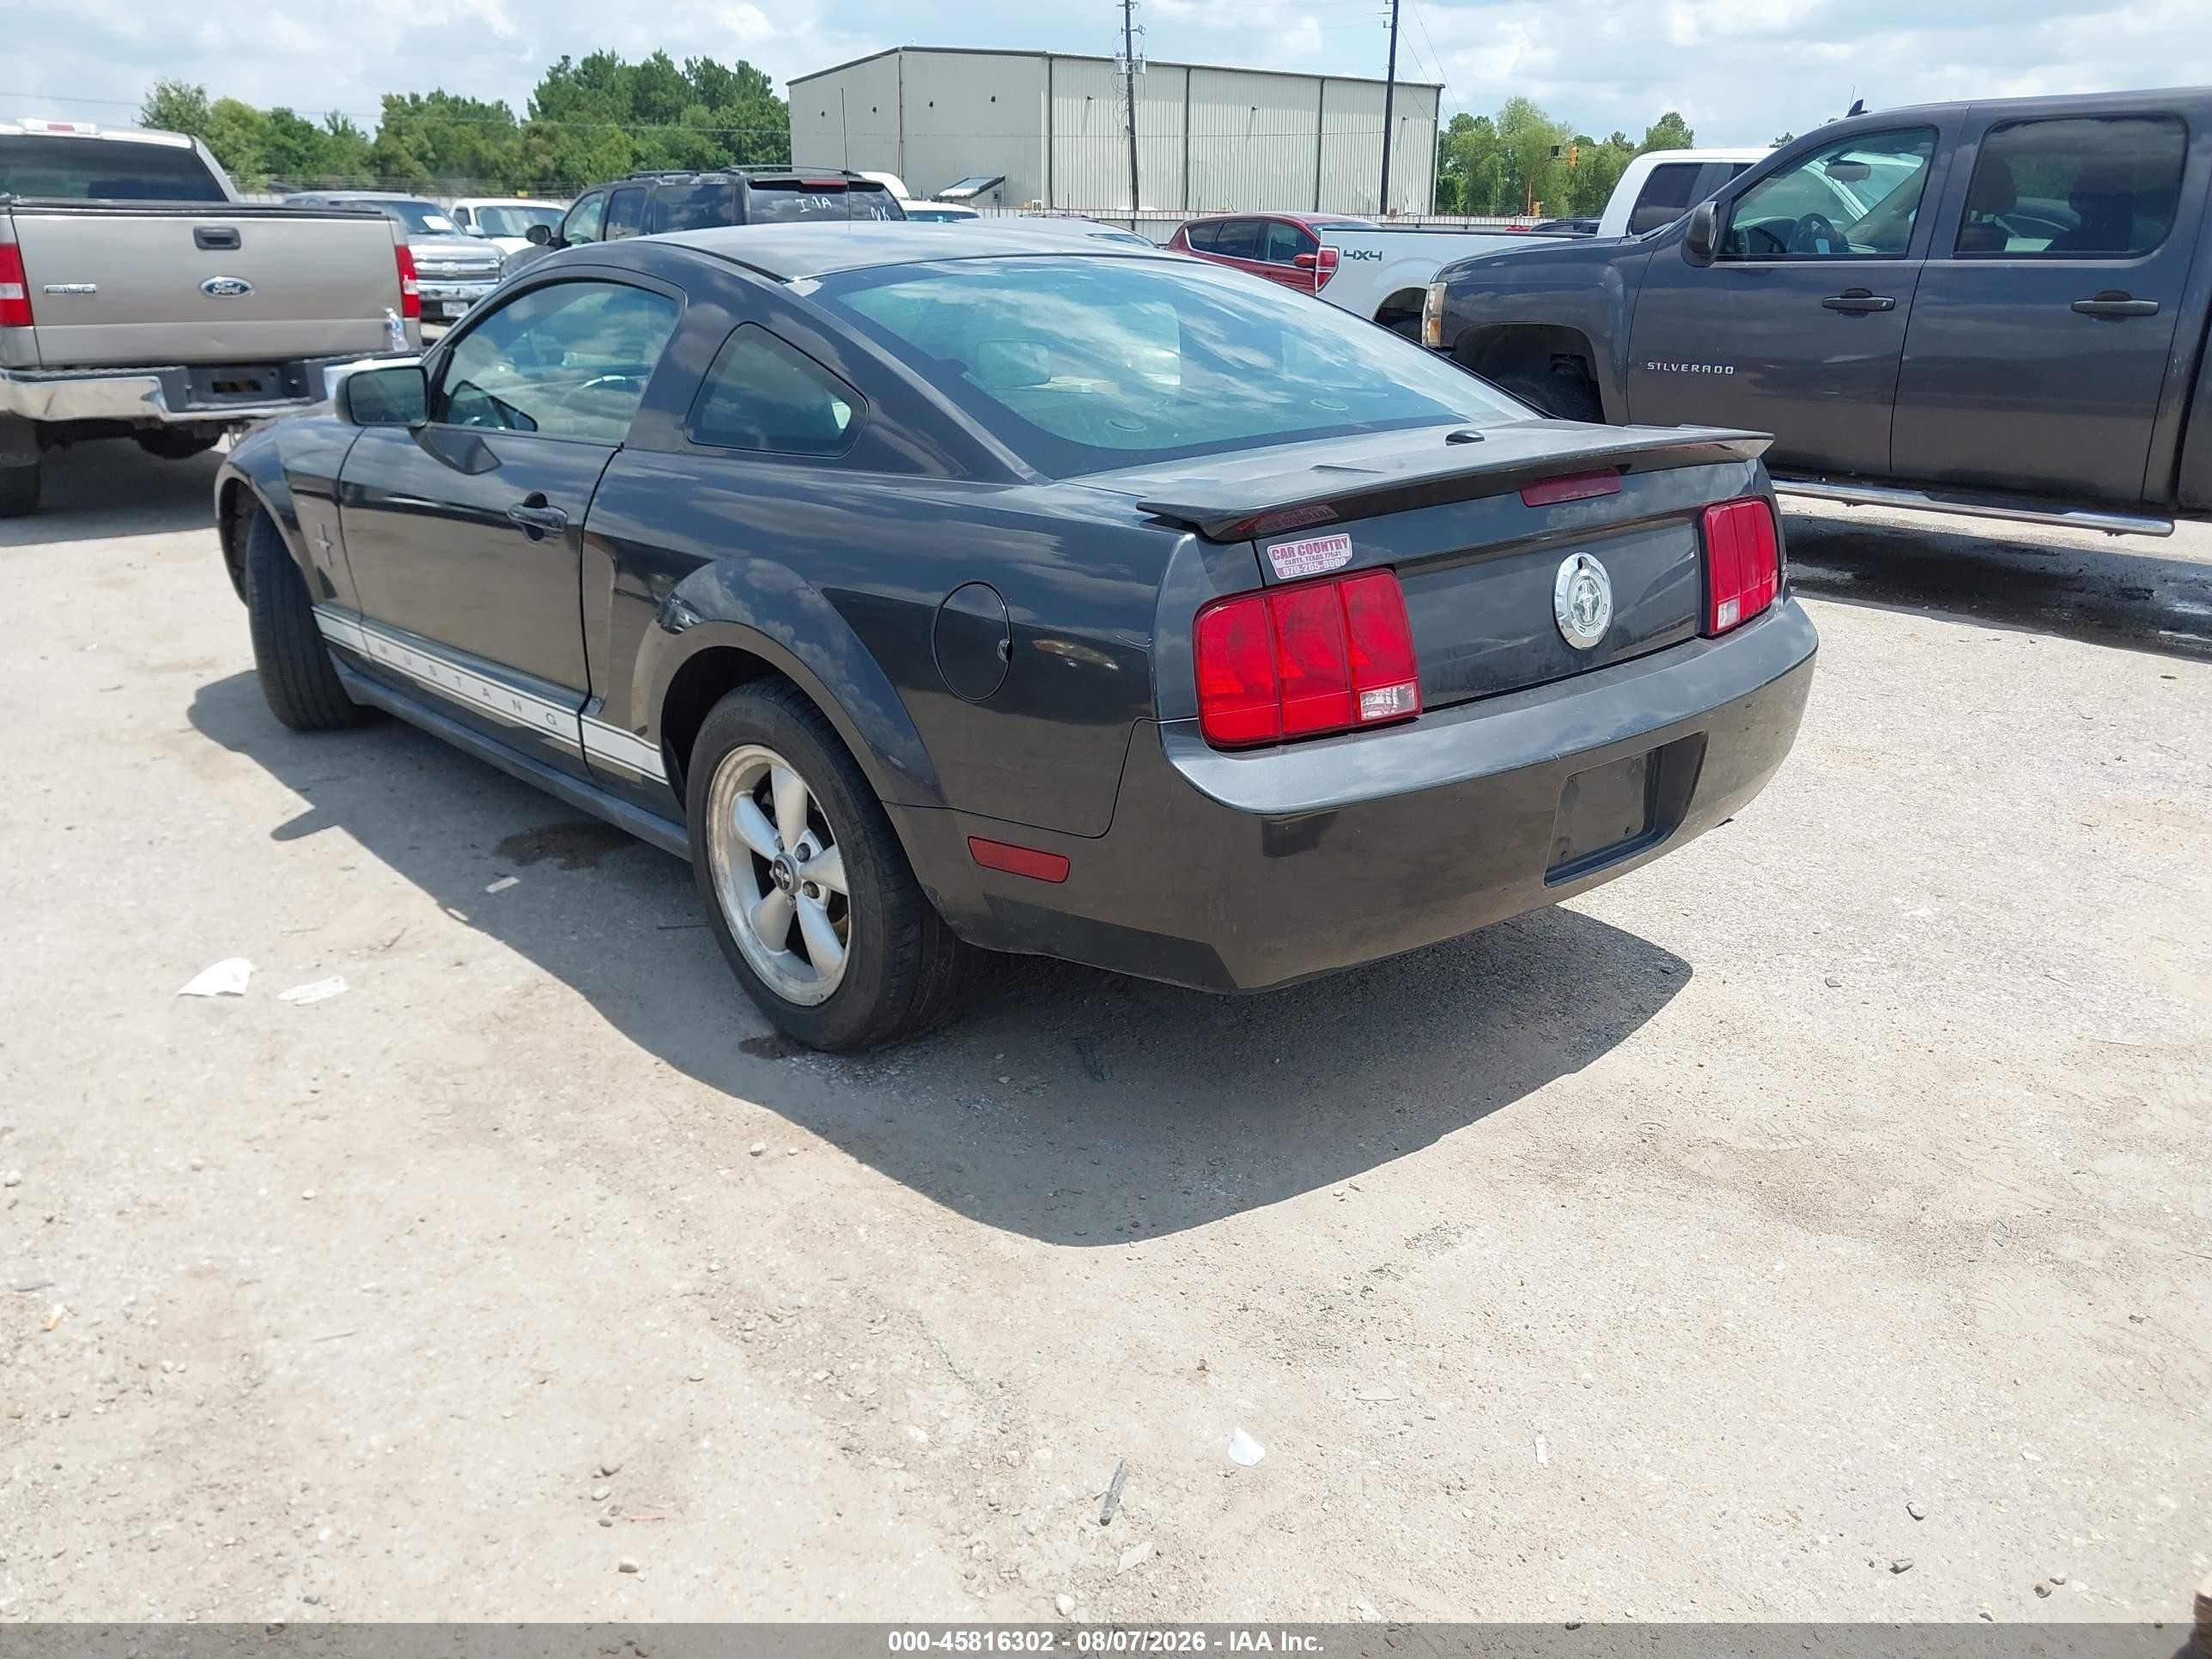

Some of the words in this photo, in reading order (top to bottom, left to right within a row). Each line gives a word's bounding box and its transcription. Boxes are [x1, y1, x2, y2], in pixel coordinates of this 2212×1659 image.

[1343, 249, 1382, 261] 4X4
[1647, 362, 1735, 374] SILVERADO
[1272, 546, 1296, 561] CAR
[1297, 538, 1348, 556] COUNTRY
[379, 644, 557, 728] MUSTANG
